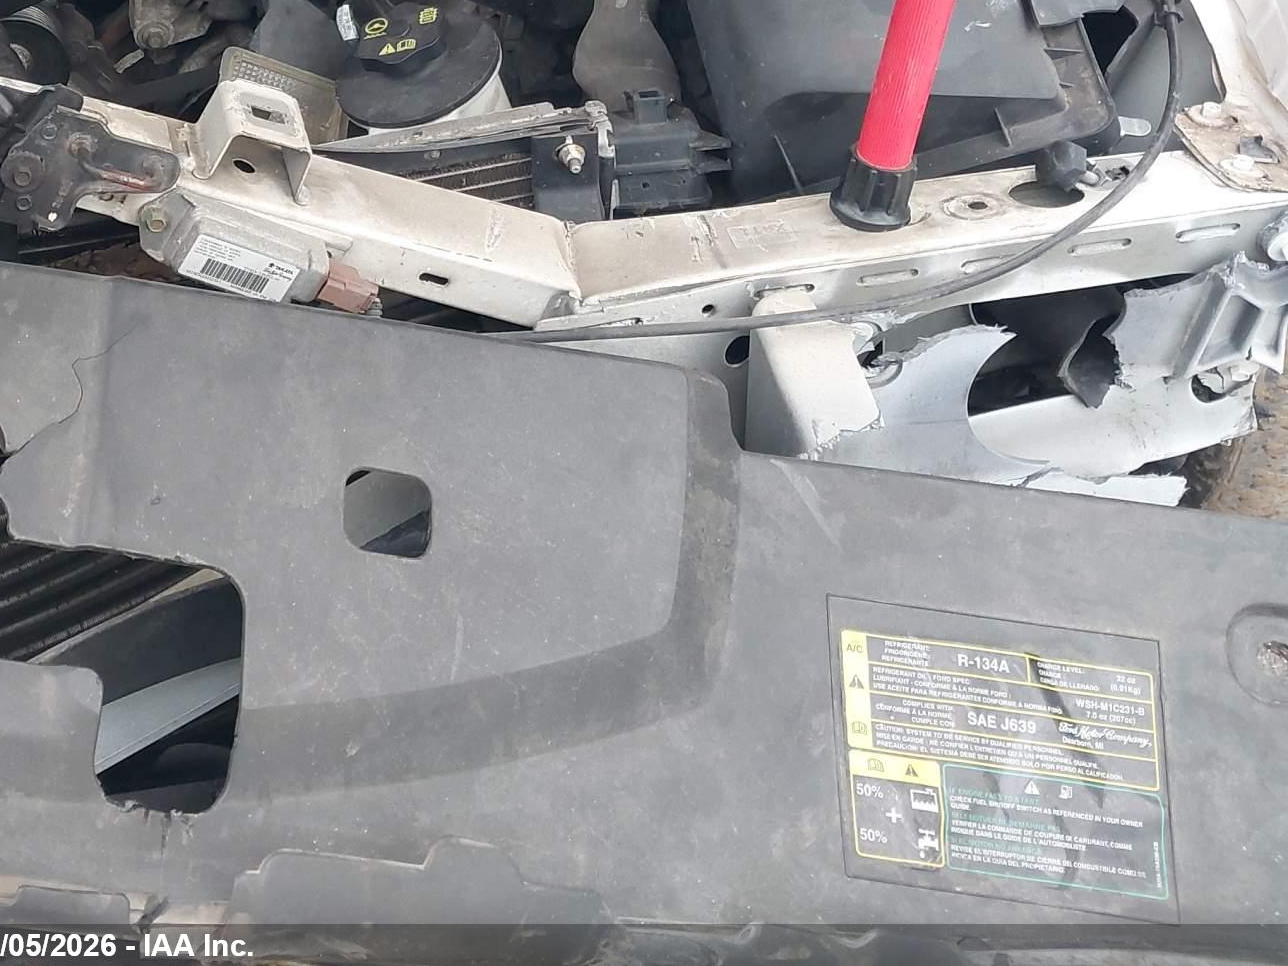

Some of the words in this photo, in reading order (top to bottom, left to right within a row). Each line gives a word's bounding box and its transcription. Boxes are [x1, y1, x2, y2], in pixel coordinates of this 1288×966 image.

[845, 642, 862, 652] A/C
[957, 653, 1010, 674] R-134A
[967, 711, 996, 728] SAE
[1000, 715, 1036, 734] J639
[855, 782, 883, 798] 50%
[859, 828, 887, 843] 50%
